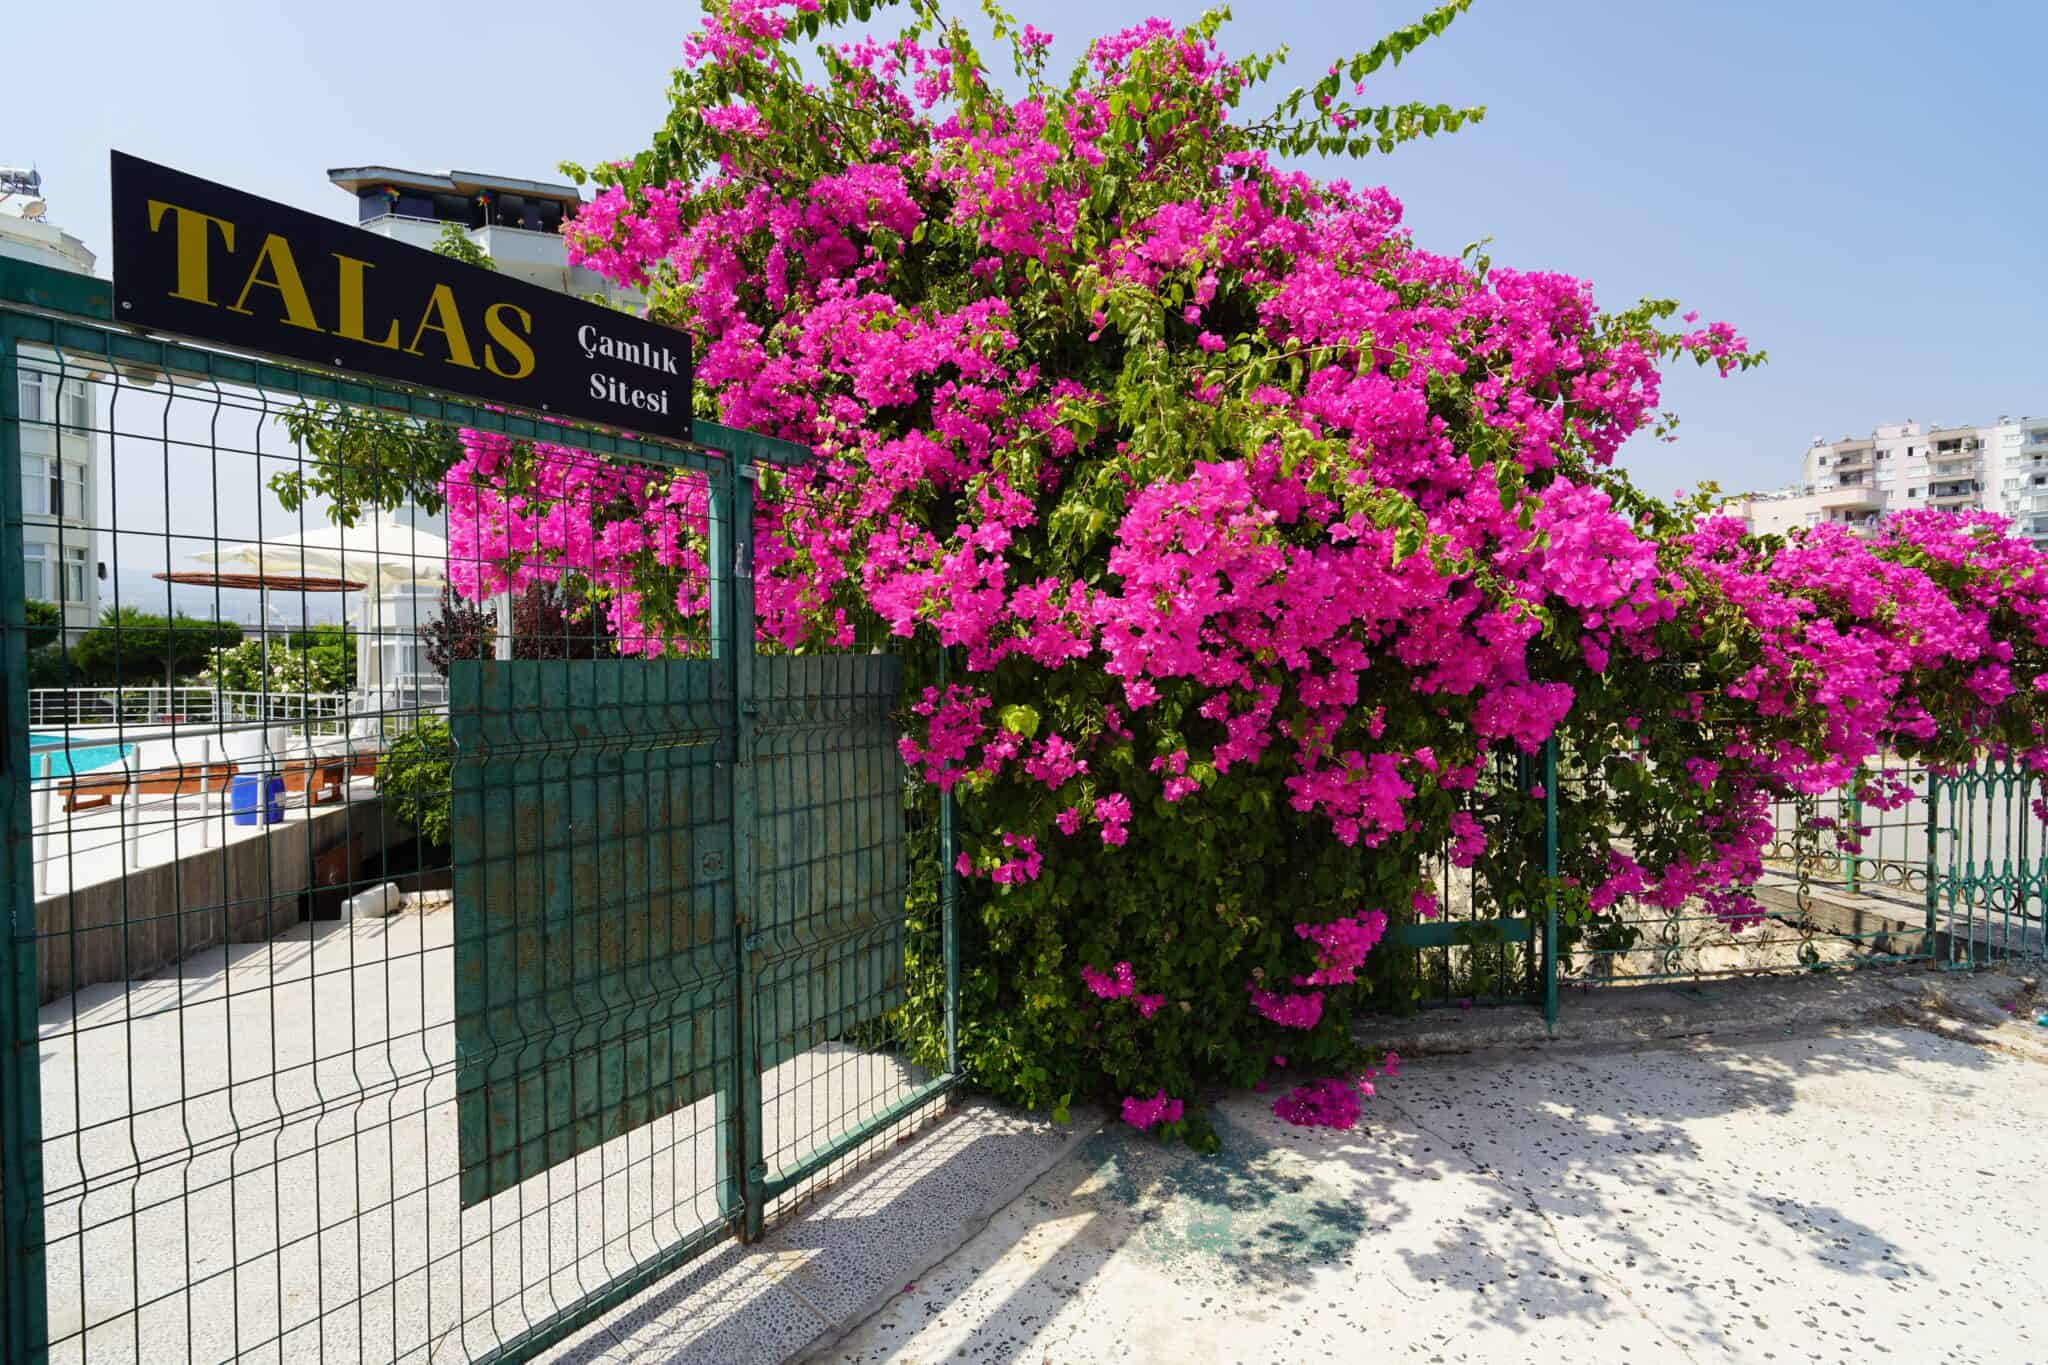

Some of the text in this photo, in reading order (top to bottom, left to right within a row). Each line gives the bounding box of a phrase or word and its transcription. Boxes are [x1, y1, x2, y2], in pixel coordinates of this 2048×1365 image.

[147, 199, 535, 380] TALAS
[577, 324, 679, 375] Çamlık
[590, 372, 668, 415] Sitesi
